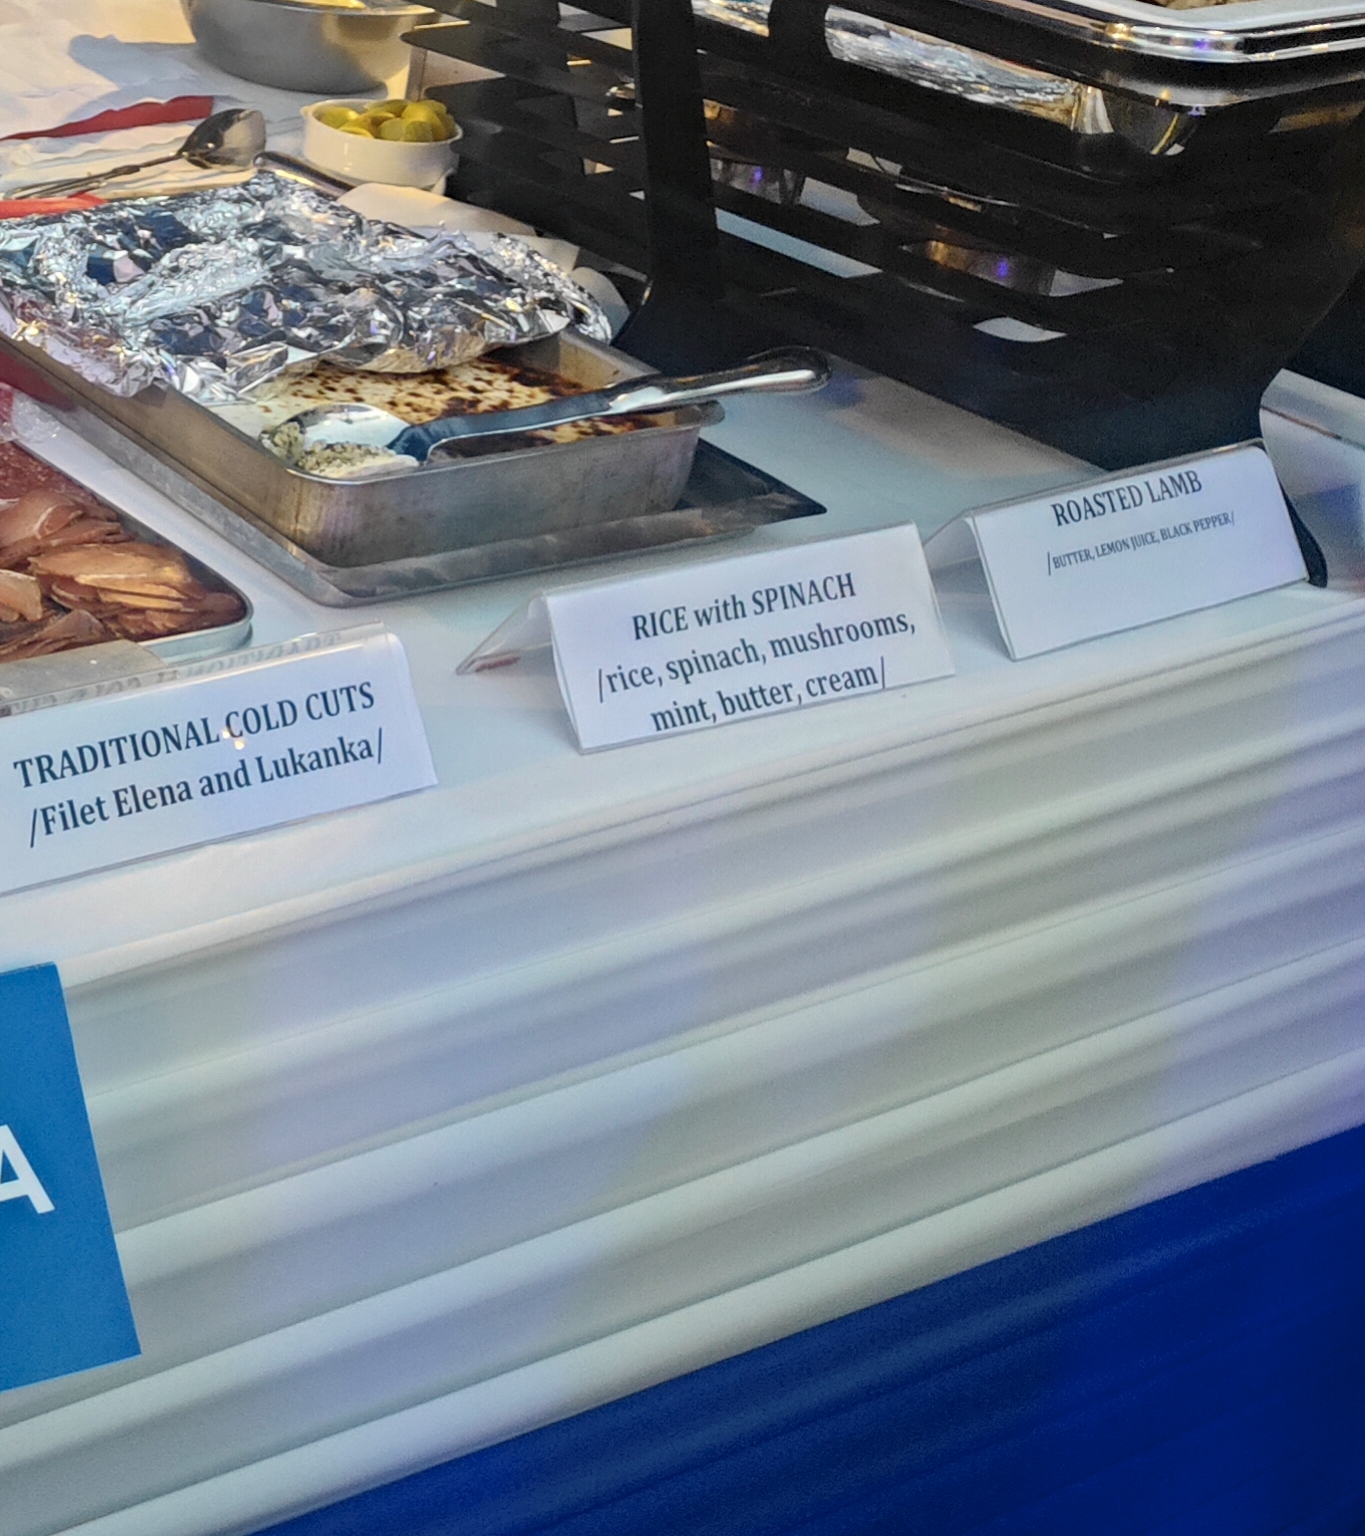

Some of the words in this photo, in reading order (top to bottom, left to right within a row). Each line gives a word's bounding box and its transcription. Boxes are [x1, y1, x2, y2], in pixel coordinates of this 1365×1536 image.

[1050, 484, 1144, 527] ROASTED
[1144, 470, 1203, 503] LAMB
[1094, 538, 1130, 557] LEMON
[1130, 531, 1160, 551] JUICE,
[1160, 522, 1193, 541] BLACK
[1194, 511, 1235, 533] PEPPER/
[632, 606, 690, 641] RICE
[693, 594, 748, 627] with
[751, 572, 856, 616] SPINACH
[598, 664, 664, 704] /rice,
[667, 638, 767, 684] spinach,
[769, 612, 916, 658] mushrooms,
[650, 697, 717, 732] mint,
[718, 681, 803, 717] butter,
[805, 655, 886, 698] cream/
[13, 716, 220, 789] TRADITIONAL
[225, 699, 298, 739] COLD
[305, 680, 375, 721] CUTS
[30, 795, 110, 849] /Filet
[113, 779, 194, 818] Elena
[198, 759, 253, 798] and
[255, 726, 384, 783] Lukanka/
